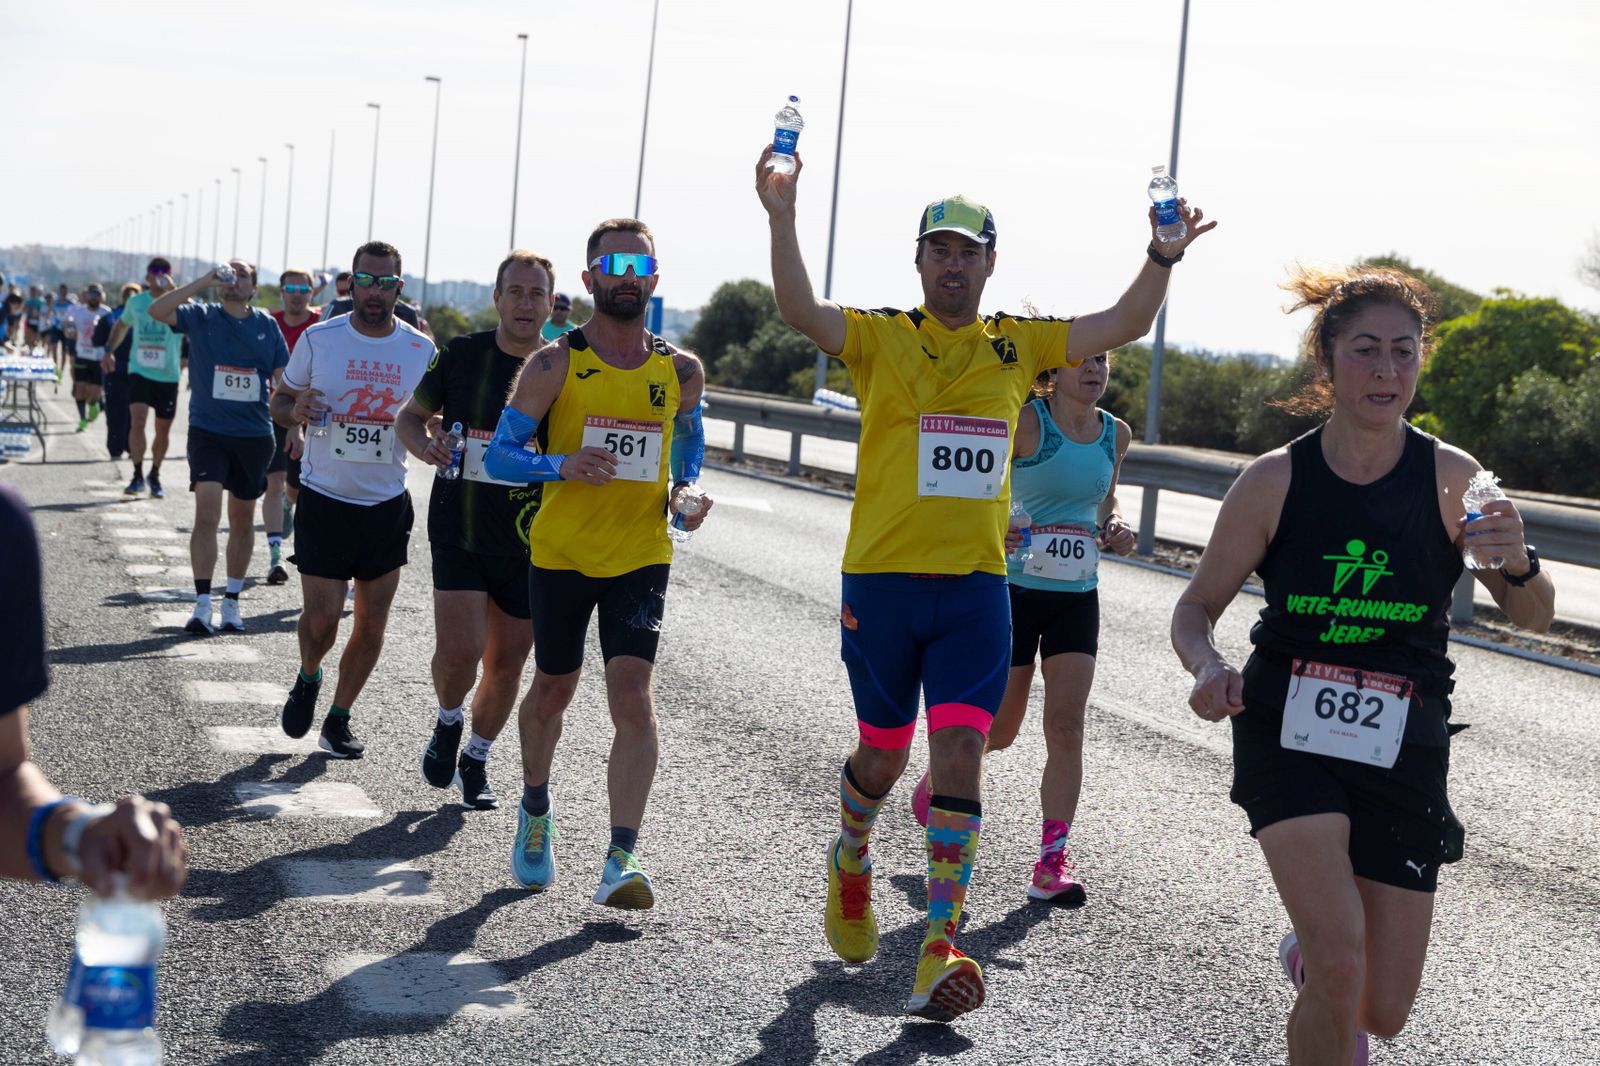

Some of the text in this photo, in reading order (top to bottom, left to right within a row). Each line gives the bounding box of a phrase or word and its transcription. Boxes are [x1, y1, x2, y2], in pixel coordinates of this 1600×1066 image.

[224, 375, 251, 389] 613
[586, 416, 617, 428] XXXVI
[922, 418, 955, 431] XXXVI
[955, 425, 976, 433] BAHÍA
[986, 427, 1007, 435] CÁDIZ
[345, 427, 381, 445] 594
[604, 433, 647, 457] 561
[932, 446, 994, 473] 800
[1045, 537, 1085, 559] 406
[1286, 594, 1428, 622] VETE-RUNNERS
[1319, 623, 1385, 644] JEREZ
[1370, 679, 1382, 688] DE
[1314, 687, 1384, 730] 682
